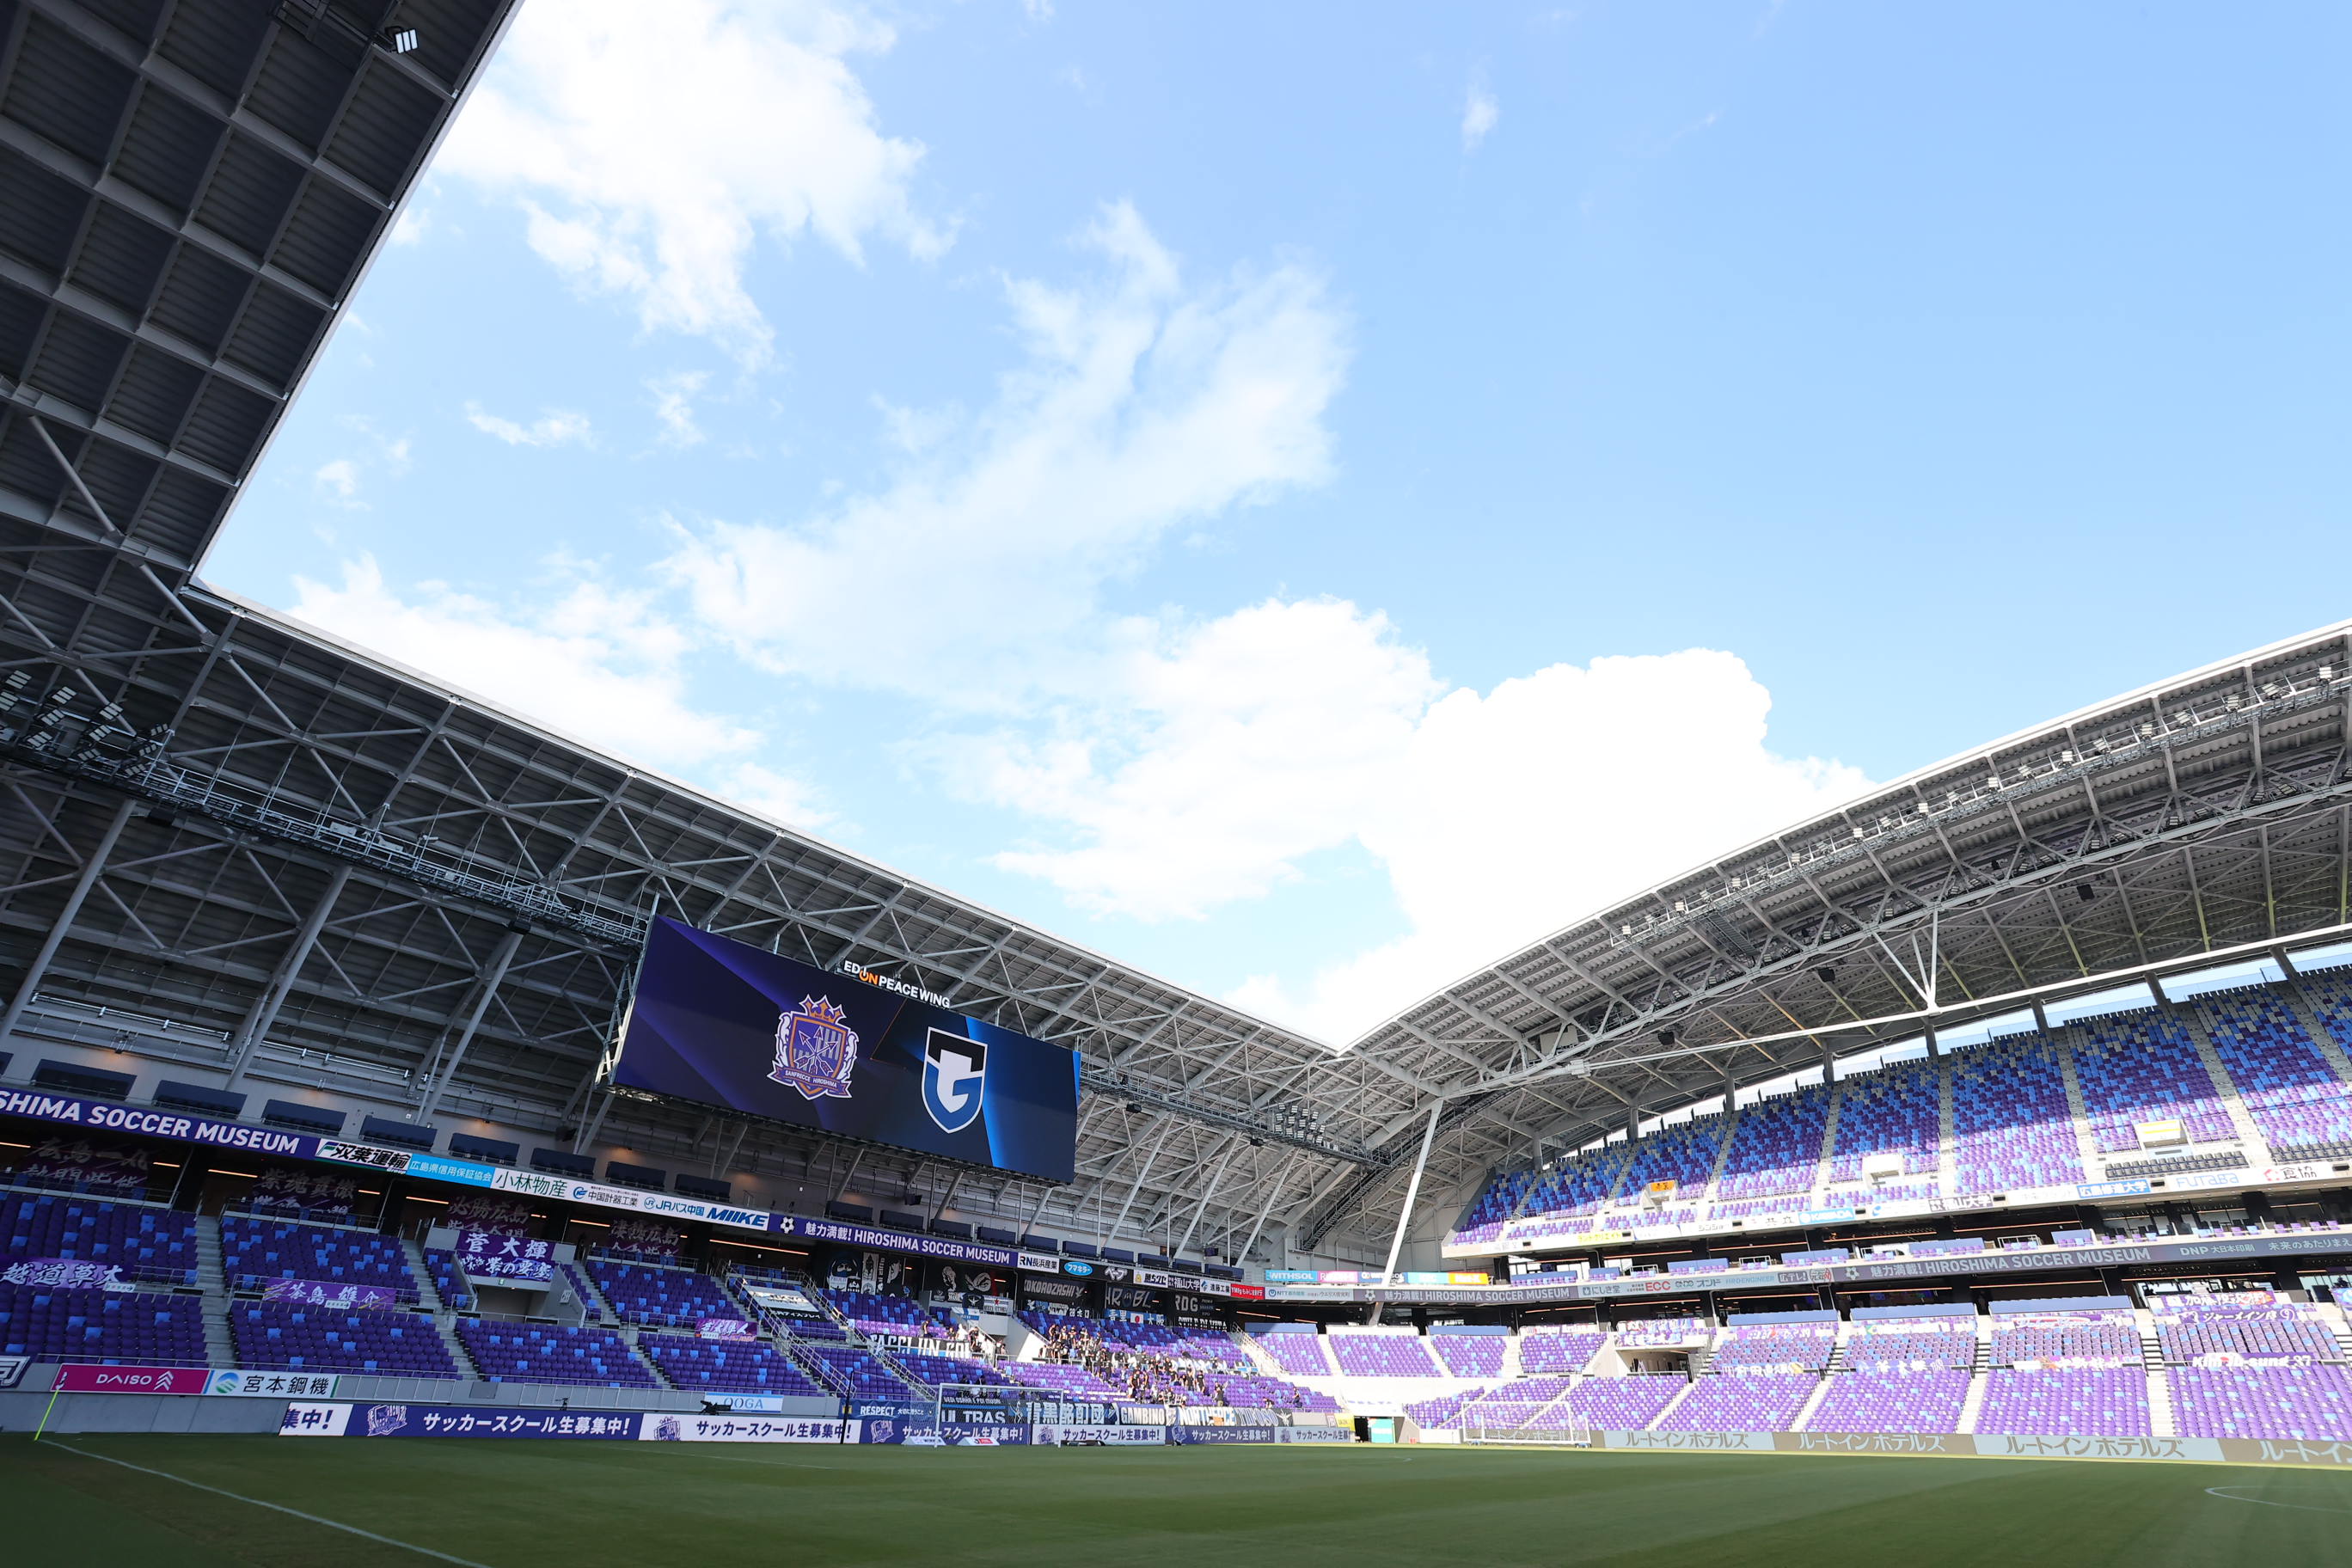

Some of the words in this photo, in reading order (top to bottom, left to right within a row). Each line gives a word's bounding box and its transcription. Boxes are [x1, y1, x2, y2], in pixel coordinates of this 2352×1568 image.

[879, 975, 919, 998] PEACE
[919, 988, 951, 1009] WING
[785, 1069, 811, 1082] SANFRECCE
[812, 1077, 837, 1088] HIROSHIMA
[87, 1106, 192, 1138] SOCCER
[194, 1121, 301, 1155] MUSEUM
[330, 1143, 412, 1169] 双葉運輸
[410, 1160, 493, 1182] 広島県信用保証協会
[495, 1171, 567, 1198] 小林物産
[588, 1191, 638, 1208] 中国計器工業
[656, 1200, 705, 1216] JRバス中国
[707, 1207, 769, 1228] MIIKE
[465, 1232, 548, 1259] 菅大輝
[805, 1222, 851, 1241] 魅力満載!
[854, 1232, 919, 1252] HIROSHIMA
[922, 1240, 964, 1258] SOCCER
[965, 1248, 1010, 1265] MUSEUM
[2180, 1247, 2208, 1256] DNP
[2212, 1244, 2255, 1253] 大日本印刷
[1032, 1258, 1058, 1270] 長浜産業
[1068, 1264, 1092, 1273] フマキラー
[1926, 1256, 2007, 1274] HIROSHIMA
[2012, 1252, 2073, 1268] SOCCER
[2077, 1247, 2151, 1265] MUSEUM
[1105, 1266, 1128, 1281] ベープ
[1174, 1277, 1200, 1290] 福山大学
[1645, 1281, 1671, 1292] ECC
[1425, 1291, 1483, 1302] HIROSHIMA
[1486, 1290, 1524, 1302] SOCCER
[1526, 1289, 1570, 1300] MUSEUM
[95, 1374, 152, 1386] DAISO
[243, 1375, 329, 1396] 宮本鋼機
[860, 1406, 896, 1416] RESPECT
[1121, 1406, 1166, 1425] GAMBINO
[423, 1412, 630, 1436] サッカースクール生募集中!
[696, 1420, 851, 1439] サッカースクール生募集中!
[1063, 1428, 1160, 1441] サッカースクール生募集中!
[1192, 1430, 1271, 1442] サッカースクール生募集中!
[1626, 1431, 1749, 1449] ルートインホテルズ
[1799, 1433, 1945, 1453] ルートインホテルズ
[2007, 1436, 2185, 1459] ルートインホテルズ
